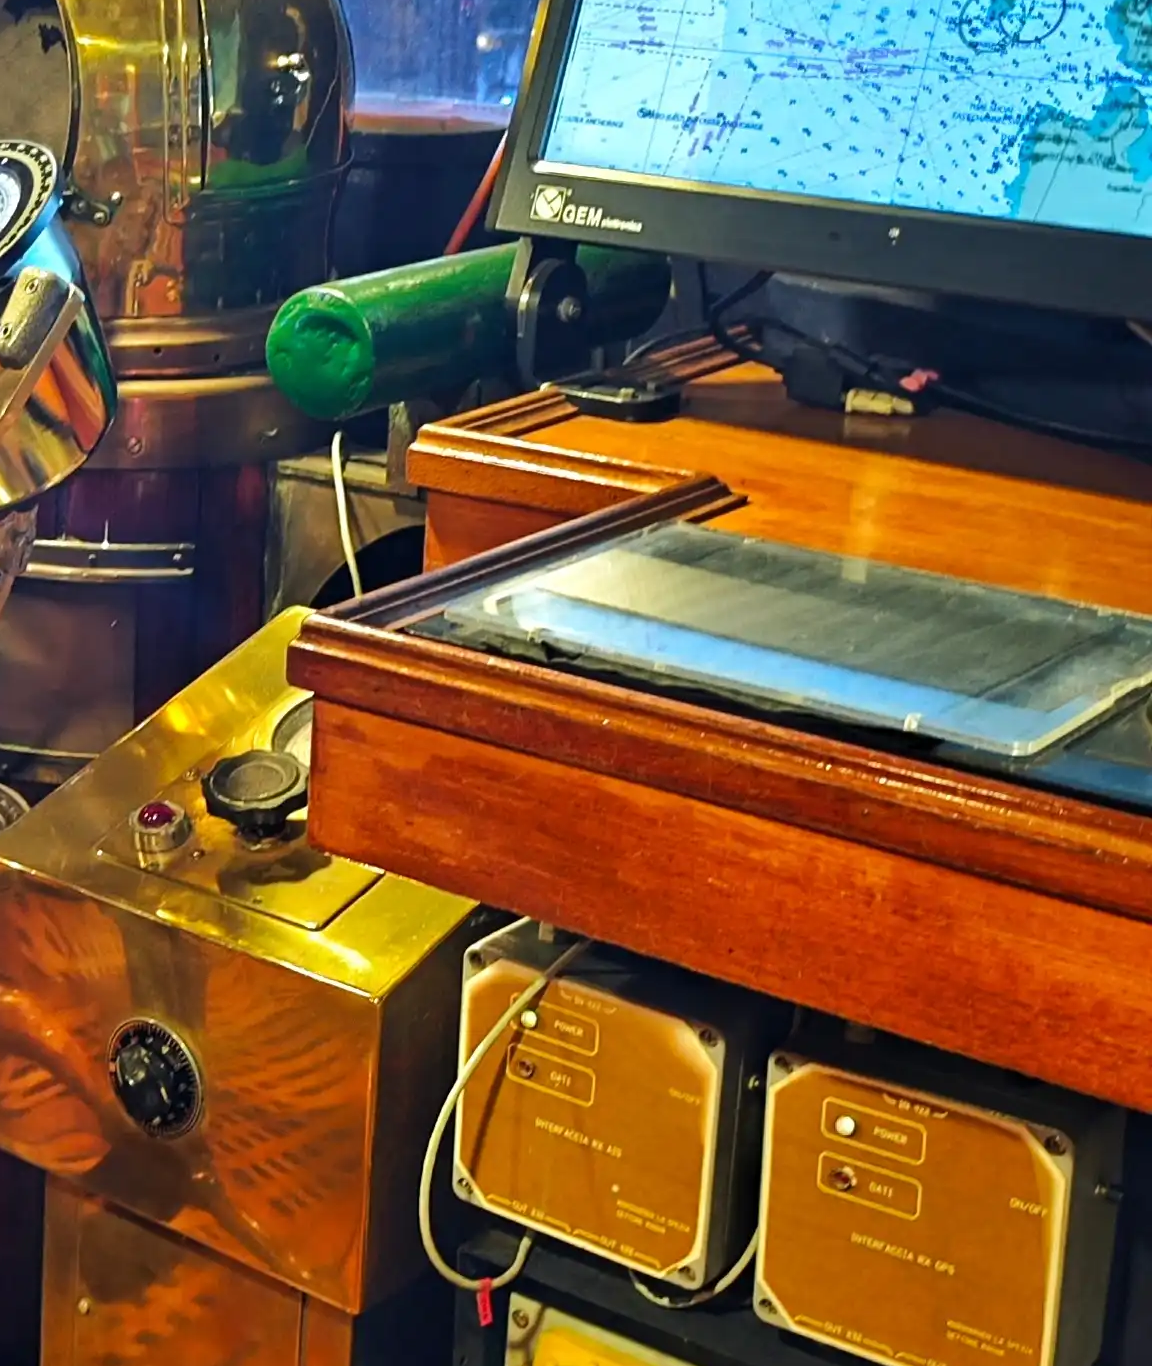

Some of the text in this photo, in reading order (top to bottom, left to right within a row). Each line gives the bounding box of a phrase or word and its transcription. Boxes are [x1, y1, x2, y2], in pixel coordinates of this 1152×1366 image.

[562, 203, 603, 228] GEM
[552, 1018, 584, 1039] POWER
[873, 1124, 909, 1146] POWER
[1009, 1197, 1049, 1219] ON/OFF
